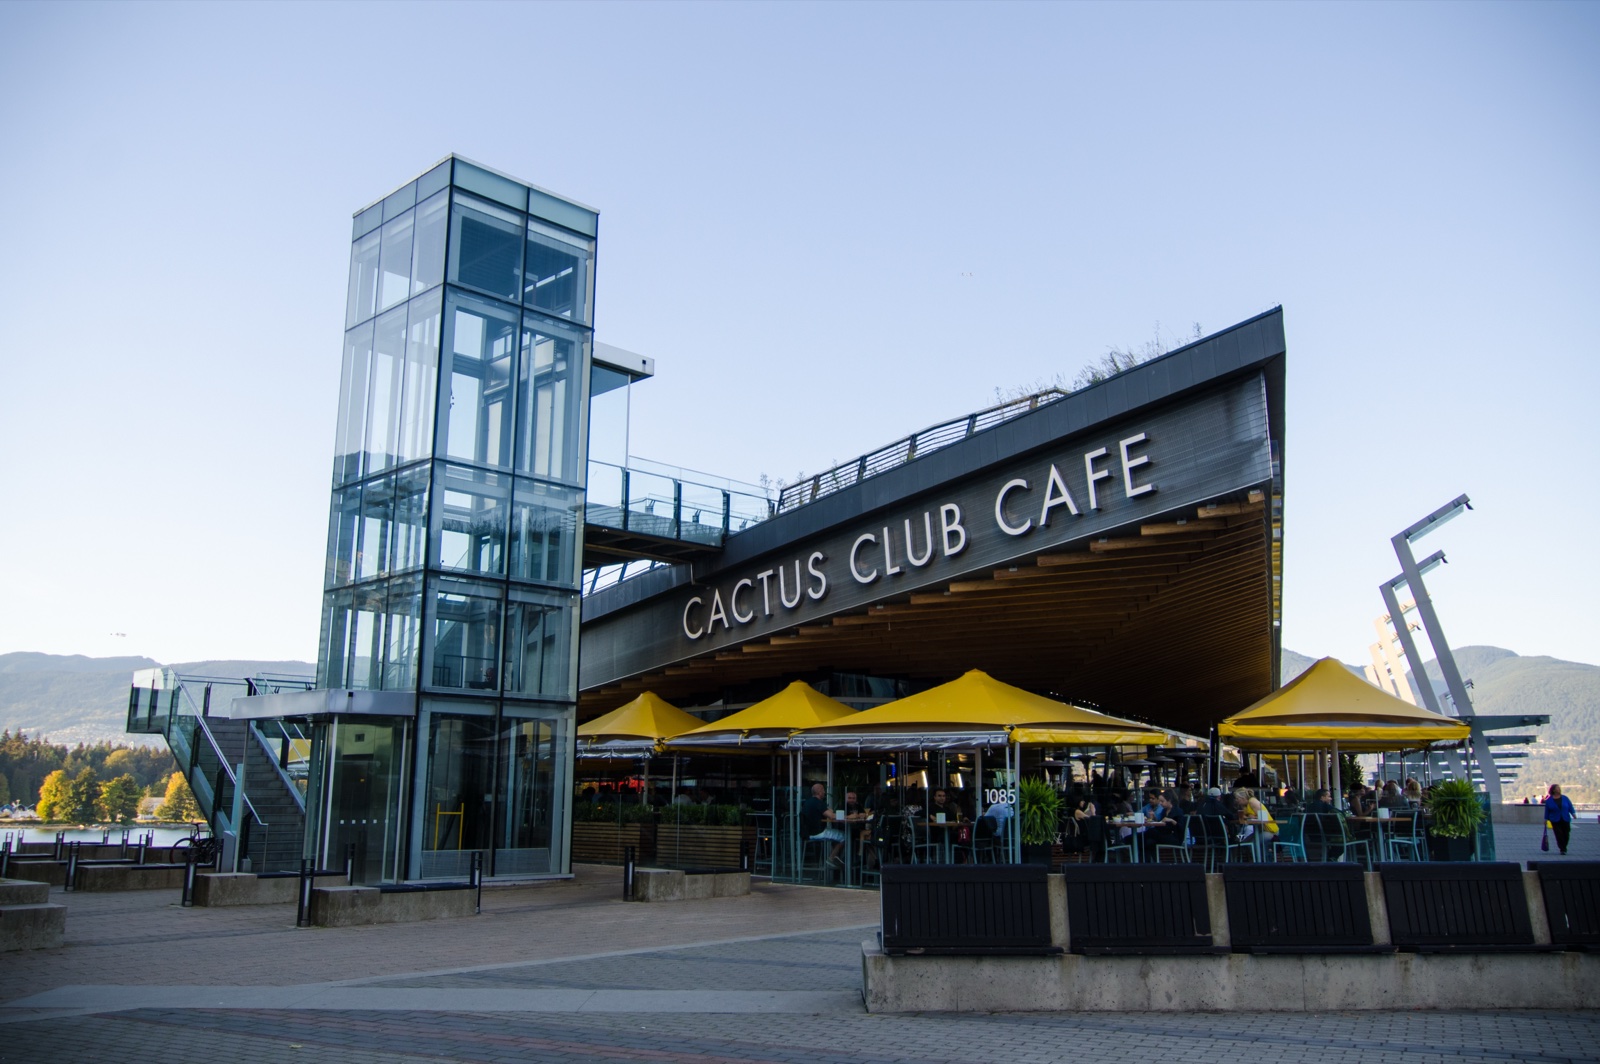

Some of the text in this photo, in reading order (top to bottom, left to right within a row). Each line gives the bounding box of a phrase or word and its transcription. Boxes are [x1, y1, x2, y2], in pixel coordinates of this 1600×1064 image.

[682, 432, 1157, 640] CACTUS CLUB CAFE
[984, 788, 1016, 804] 1085
